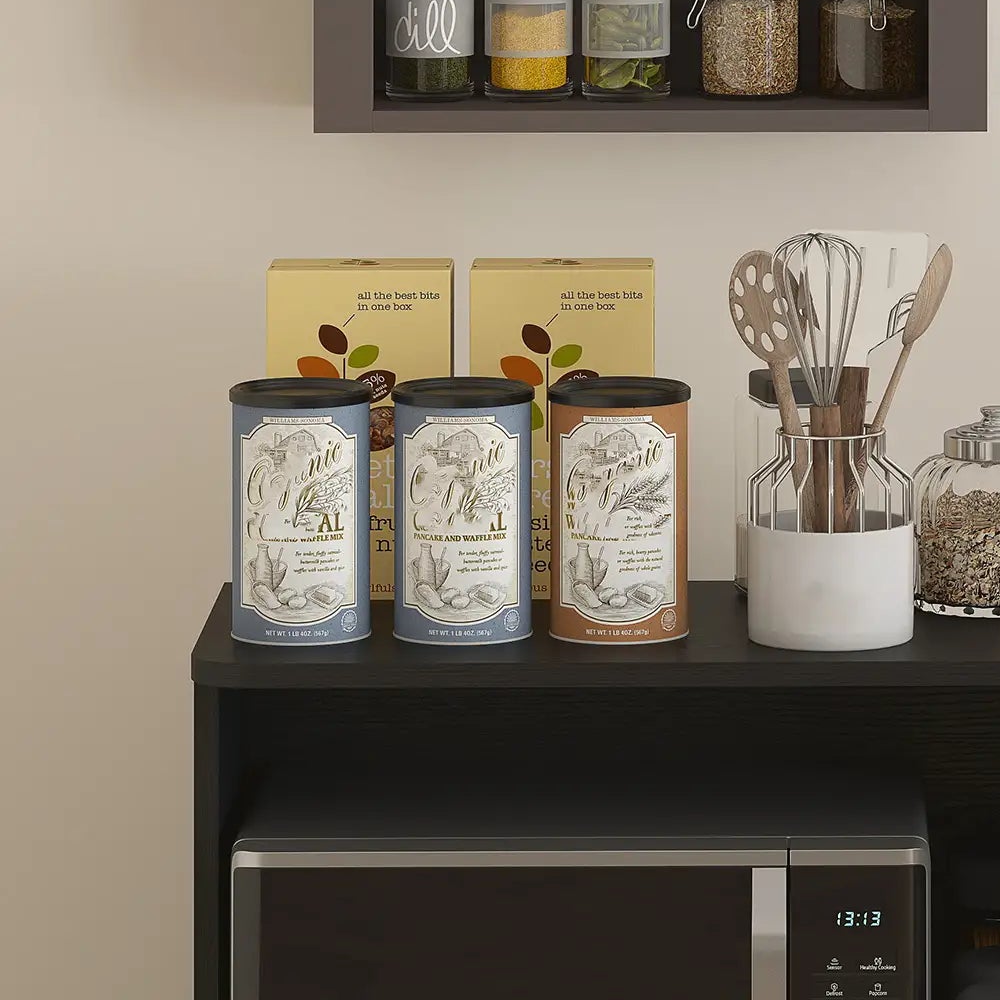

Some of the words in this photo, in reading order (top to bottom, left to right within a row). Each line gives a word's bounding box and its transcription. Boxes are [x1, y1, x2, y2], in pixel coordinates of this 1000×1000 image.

[357, 291, 371, 300] all
[374, 291, 392, 300] the
[395, 291, 417, 300] best
[419, 291, 440, 300] bits
[560, 291, 574, 300] all
[577, 291, 595, 300] the
[597, 291, 620, 300] best
[622, 291, 643, 300] bits
[357, 302, 368, 311] in
[371, 303, 390, 311] one
[393, 302, 412, 311] box
[560, 302, 571, 310] in
[596, 302, 615, 310] box
[413, 533, 443, 541] PANCAKE
[462, 534, 492, 542] WAFFLE
[837, 911, 881, 927] 13:13
